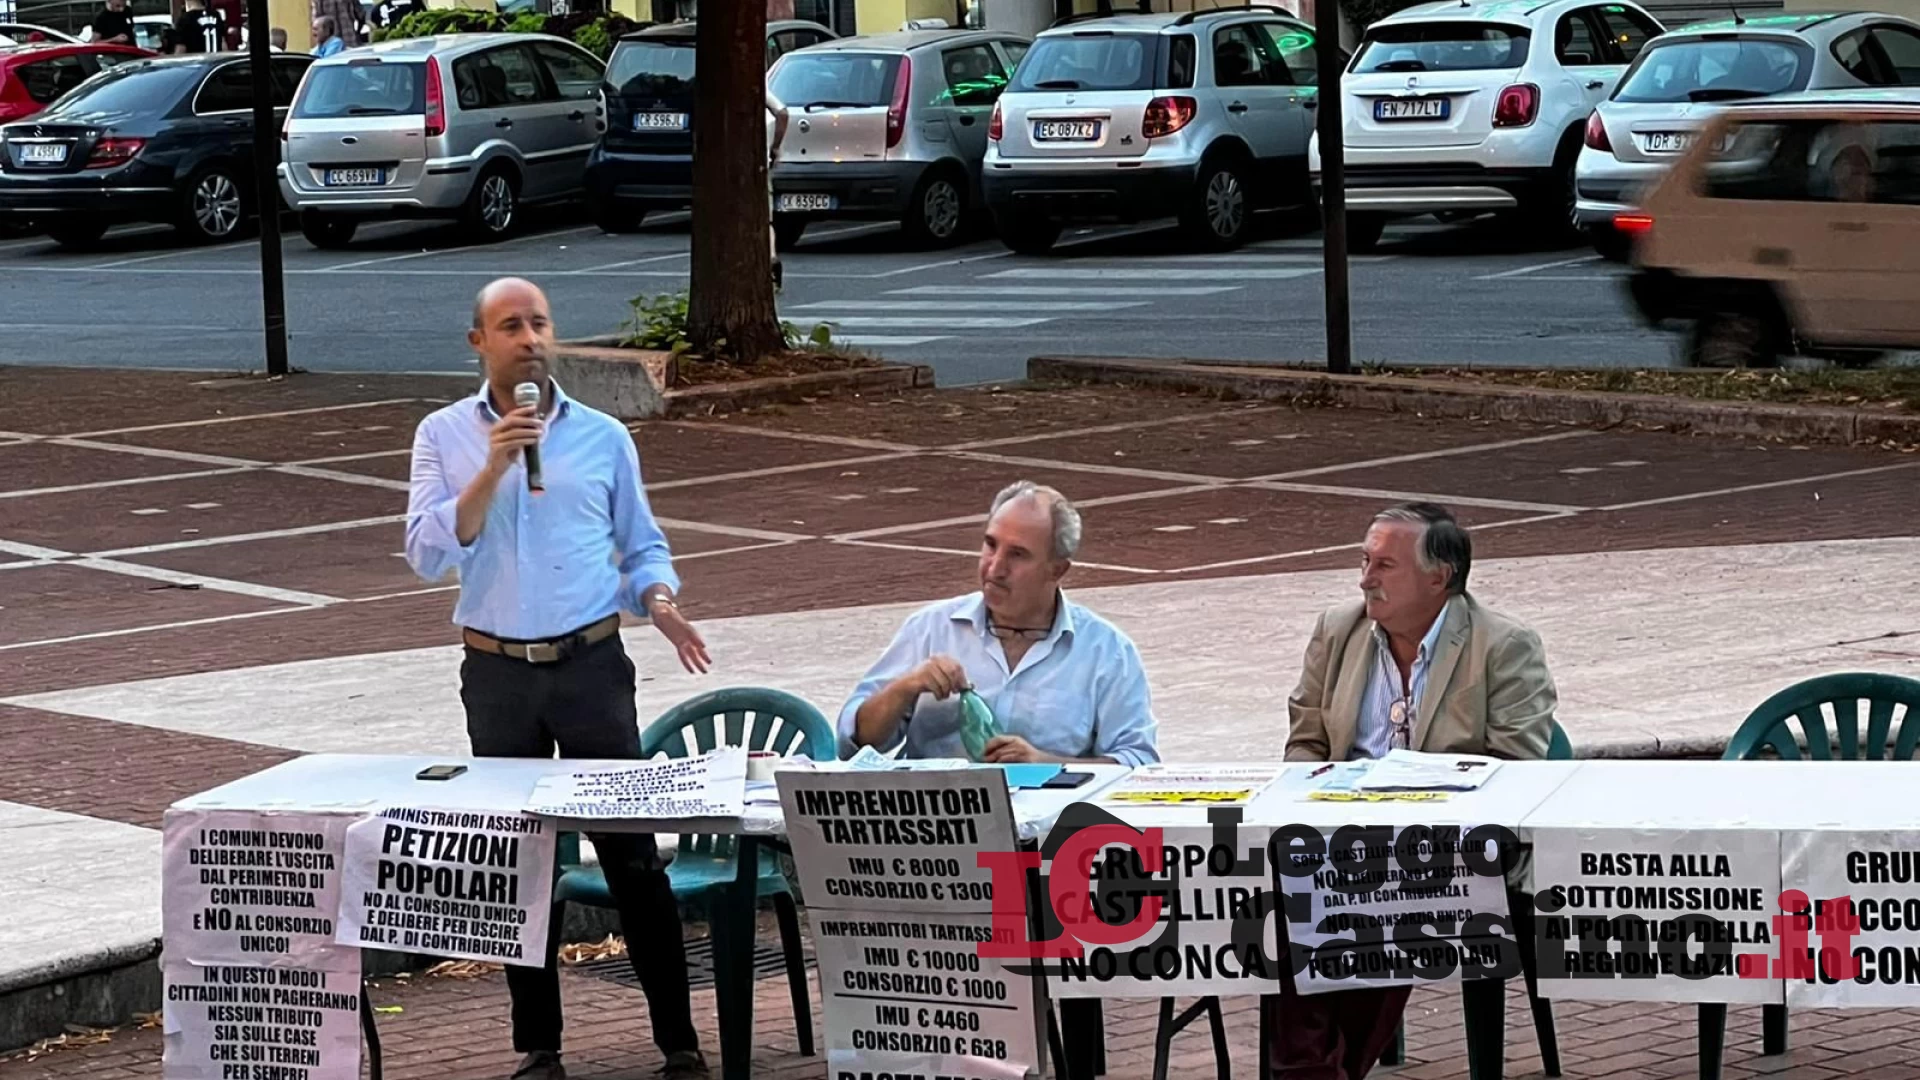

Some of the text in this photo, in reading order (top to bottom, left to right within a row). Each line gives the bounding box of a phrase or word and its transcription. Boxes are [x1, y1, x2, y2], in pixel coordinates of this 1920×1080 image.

[1383, 100, 1439, 117] FN 717LY
[1653, 135, 1669, 150] DR
[795, 788, 991, 816] IMPRENDITORI
[376, 808, 542, 834] MINISTRATORI ASSENTI
[817, 818, 978, 845] TARTASSATI
[208, 830, 266, 848] COMUNI
[269, 832, 324, 849] DEVONO
[381, 825, 518, 869] PETIZIONI
[189, 848, 335, 870] DELIBERARE L'USCITA
[1077, 844, 1234, 880] GRUPPO
[1293, 853, 1326, 867] SORA
[1335, 846, 1398, 861] CASTELLIRI
[1408, 842, 1443, 857] ISOLA
[1445, 841, 1462, 854] DEL
[1580, 853, 1732, 877] BASTA ALLA
[200, 869, 325, 889] DAL PERIMETRO DI
[849, 857, 960, 877] IMU € 8000
[1313, 866, 1474, 890] NON DELIBERANO L'USCITA
[377, 860, 518, 905] POPOLARI
[826, 879, 994, 901] CONSORZIO € 1300
[210, 888, 315, 908] CONTRIBUENZA
[363, 892, 527, 924] NO AL CONSORZIO UNICO
[1056, 886, 1263, 924] CASTELLIRI
[1324, 885, 1469, 907] DAL P. DI CONTRIBUENZA E
[1550, 884, 1763, 911] SOTTOMISSIONE
[193, 908, 332, 935] E NO AL CONSORZIO
[367, 910, 520, 941] E DELIBERE PER USCIRE
[820, 921, 1016, 944] IMPRENDITORI TARTASSATI
[1326, 909, 1473, 932] NO AL CONSORZIO UNICO
[1545, 917, 1771, 944] AI POLITICI DELLA
[240, 935, 290, 953] UNICO!
[359, 925, 523, 959] DAL P. DI CONTRIBUENZA
[864, 947, 980, 972] IMU € 10000
[1060, 943, 1268, 982] NO CONCA
[1308, 944, 1502, 978] PETIZIONI POPOLARI
[1564, 951, 1753, 976] REGIONE LAZIO
[1792, 946, 1843, 985] NO
[203, 966, 219, 982] IN
[222, 967, 276, 986] QUESTO
[279, 969, 319, 987] MODO
[844, 971, 1007, 1000] CONSORZIO € 1000
[167, 984, 357, 1011] CITTADINI NON PAGHERANNO
[207, 1006, 323, 1027] NESSUN TRIBUTO
[876, 1006, 980, 1031] IMU € 4460
[215, 1025, 316, 1046] SIA SULLE CASE
[852, 1030, 1007, 1060] CONSORZIO € 638
[210, 1044, 320, 1066] CHE SUI TERRENI
[223, 1064, 249, 1080] PER
